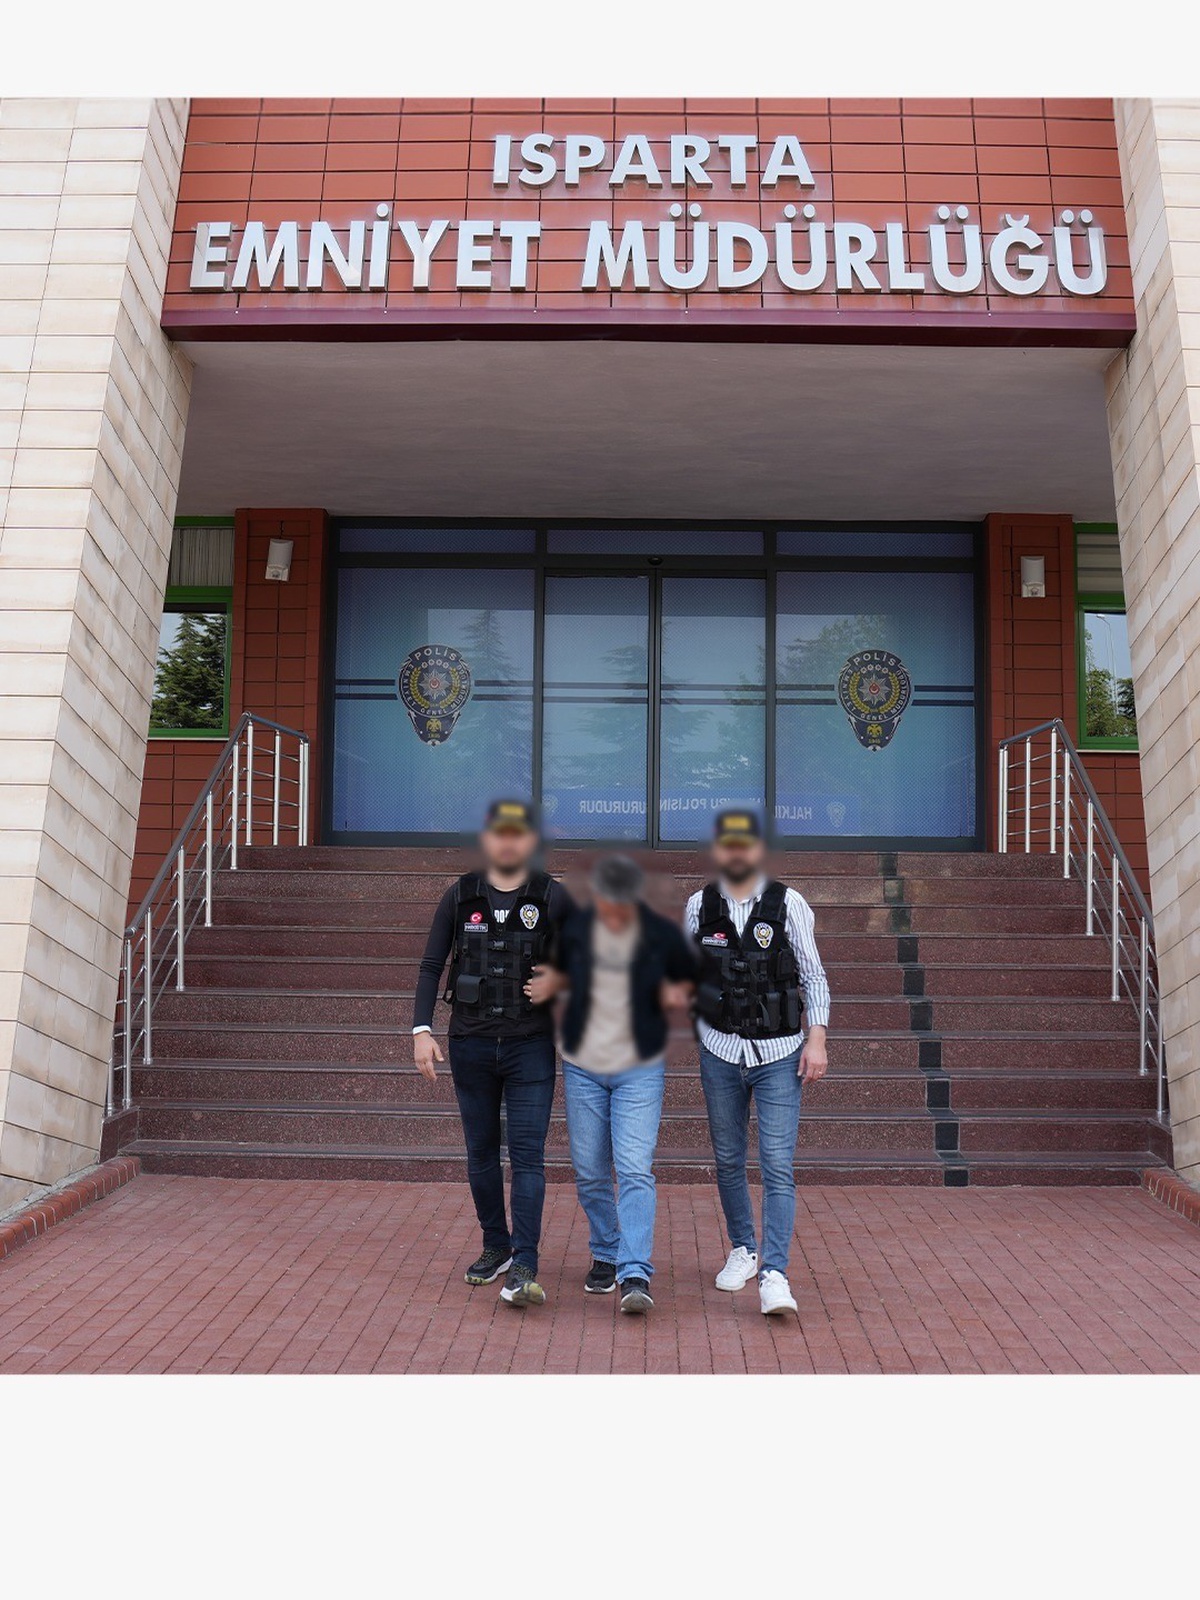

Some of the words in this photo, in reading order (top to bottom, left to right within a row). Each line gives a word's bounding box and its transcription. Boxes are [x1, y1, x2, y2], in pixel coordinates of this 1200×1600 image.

[492, 133, 816, 188] ISPARTA
[189, 203, 541, 291] EMNİYET
[582, 203, 1108, 297] MÜDÜRLÜĞÜ
[414, 647, 457, 661] POLİS
[853, 652, 897, 667] POLİS
